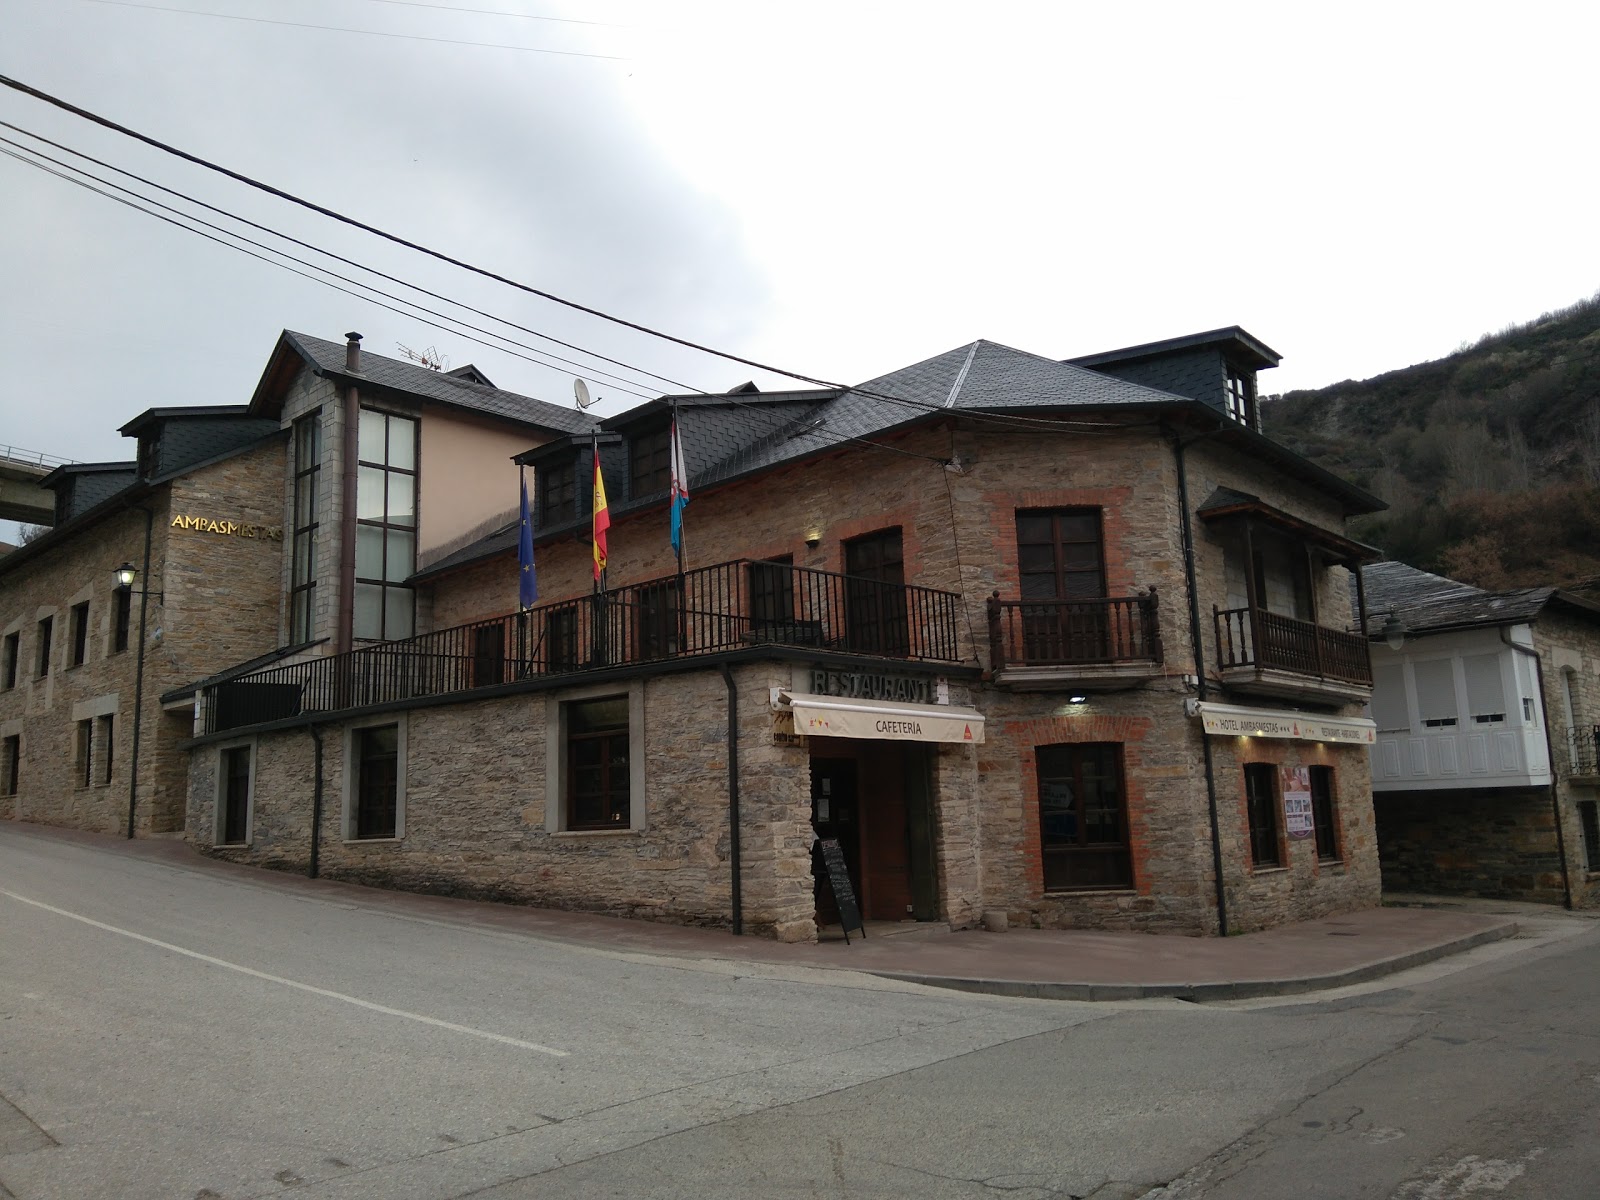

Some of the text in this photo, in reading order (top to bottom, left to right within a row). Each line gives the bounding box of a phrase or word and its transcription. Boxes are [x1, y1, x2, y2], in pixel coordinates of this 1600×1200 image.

[171, 514, 283, 541] AMBASMESTAS
[811, 670, 940, 705] RESTAURANTE
[875, 719, 922, 735] CAFETERÍA
[1219, 719, 1279, 733] HOTEL AMBASMESTAS
